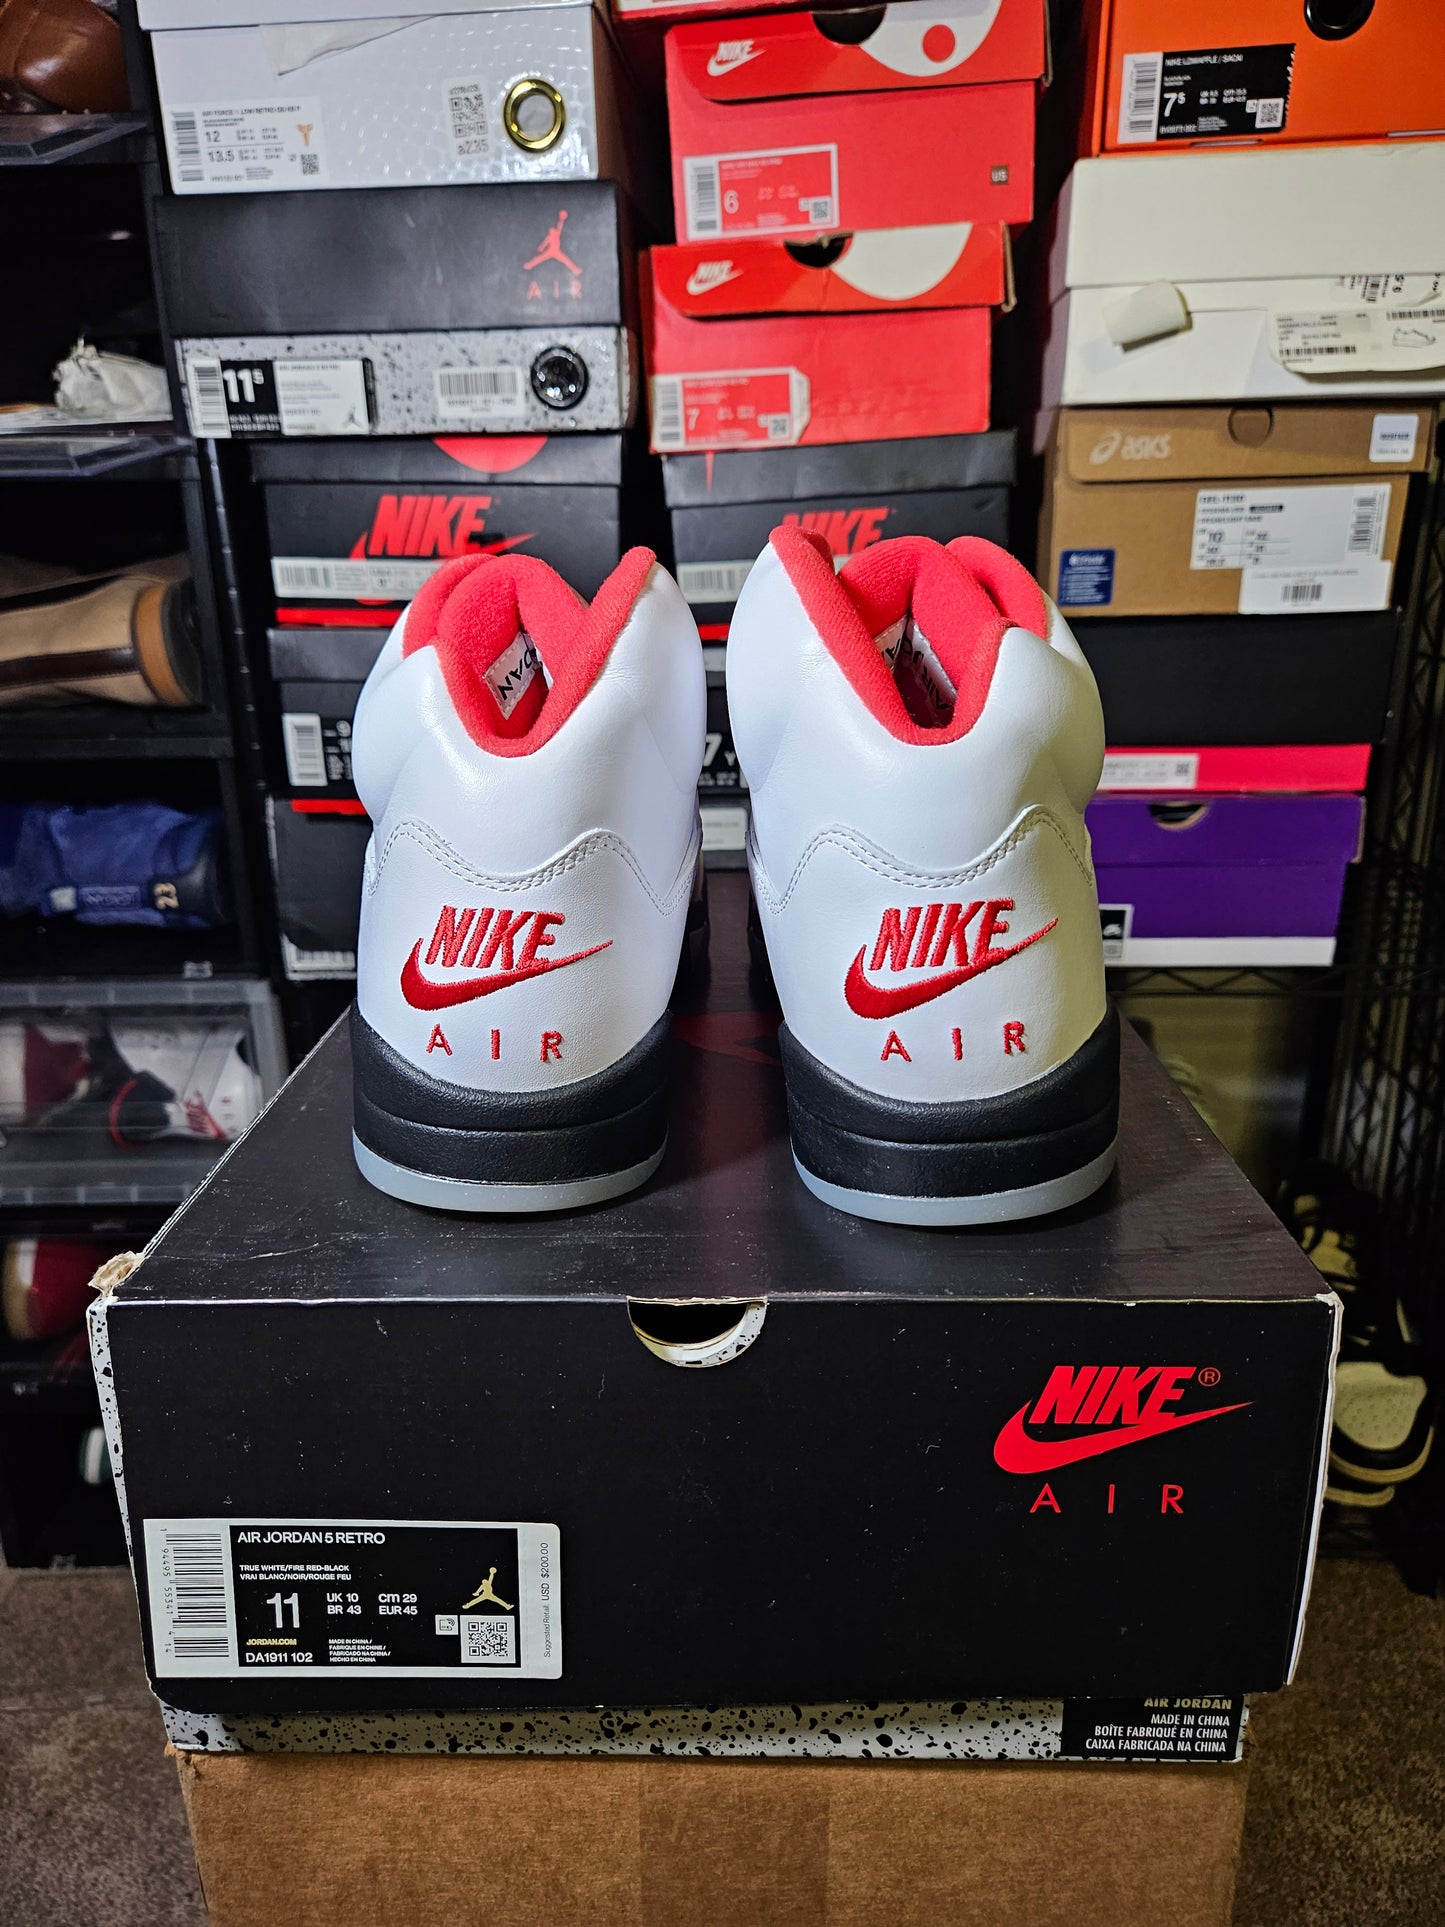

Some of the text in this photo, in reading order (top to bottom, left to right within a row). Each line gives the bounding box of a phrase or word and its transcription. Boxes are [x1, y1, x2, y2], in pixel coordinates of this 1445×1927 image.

[716, 39, 755, 61] NIKE
[205, 130, 221, 143] 12
[208, 150, 234, 162] 13.5
[724, 190, 739, 214] 6
[527, 281, 582, 299] AIR
[687, 408, 700, 430] 7
[367, 494, 492, 557] NIKE
[425, 905, 565, 970] NIKE
[869, 897, 1013, 972] NIKE
[426, 1024, 563, 1062] AIR
[881, 1021, 1026, 1062] AIR
[1028, 1366, 1197, 1425] NIKE
[1029, 1483, 1184, 1514] AIR
[238, 1532, 386, 1544] AIR JORDAN 5 RETRO
[261, 1564, 304, 1572] WHITE/FIRE
[540, 1542, 550, 1578] $200.00
[326, 1593, 359, 1603] UK 10
[402, 1593, 418, 1603] 29
[541, 1583, 550, 1601] USD
[266, 1592, 300, 1629] 11
[327, 1605, 362, 1615] BR 43
[378, 1605, 419, 1615] EUR 45
[245, 1652, 313, 1663] DA1911 102
[1144, 1697, 1232, 1710] AIR JORDAN
[1150, 1713, 1230, 1727] MADE IN CHINA
[1094, 1724, 1228, 1739] BOÎTE FABRIQUÉ EN CHINA
[1085, 1738, 1226, 1752] CAIXA FABRICADA NA CHINA
